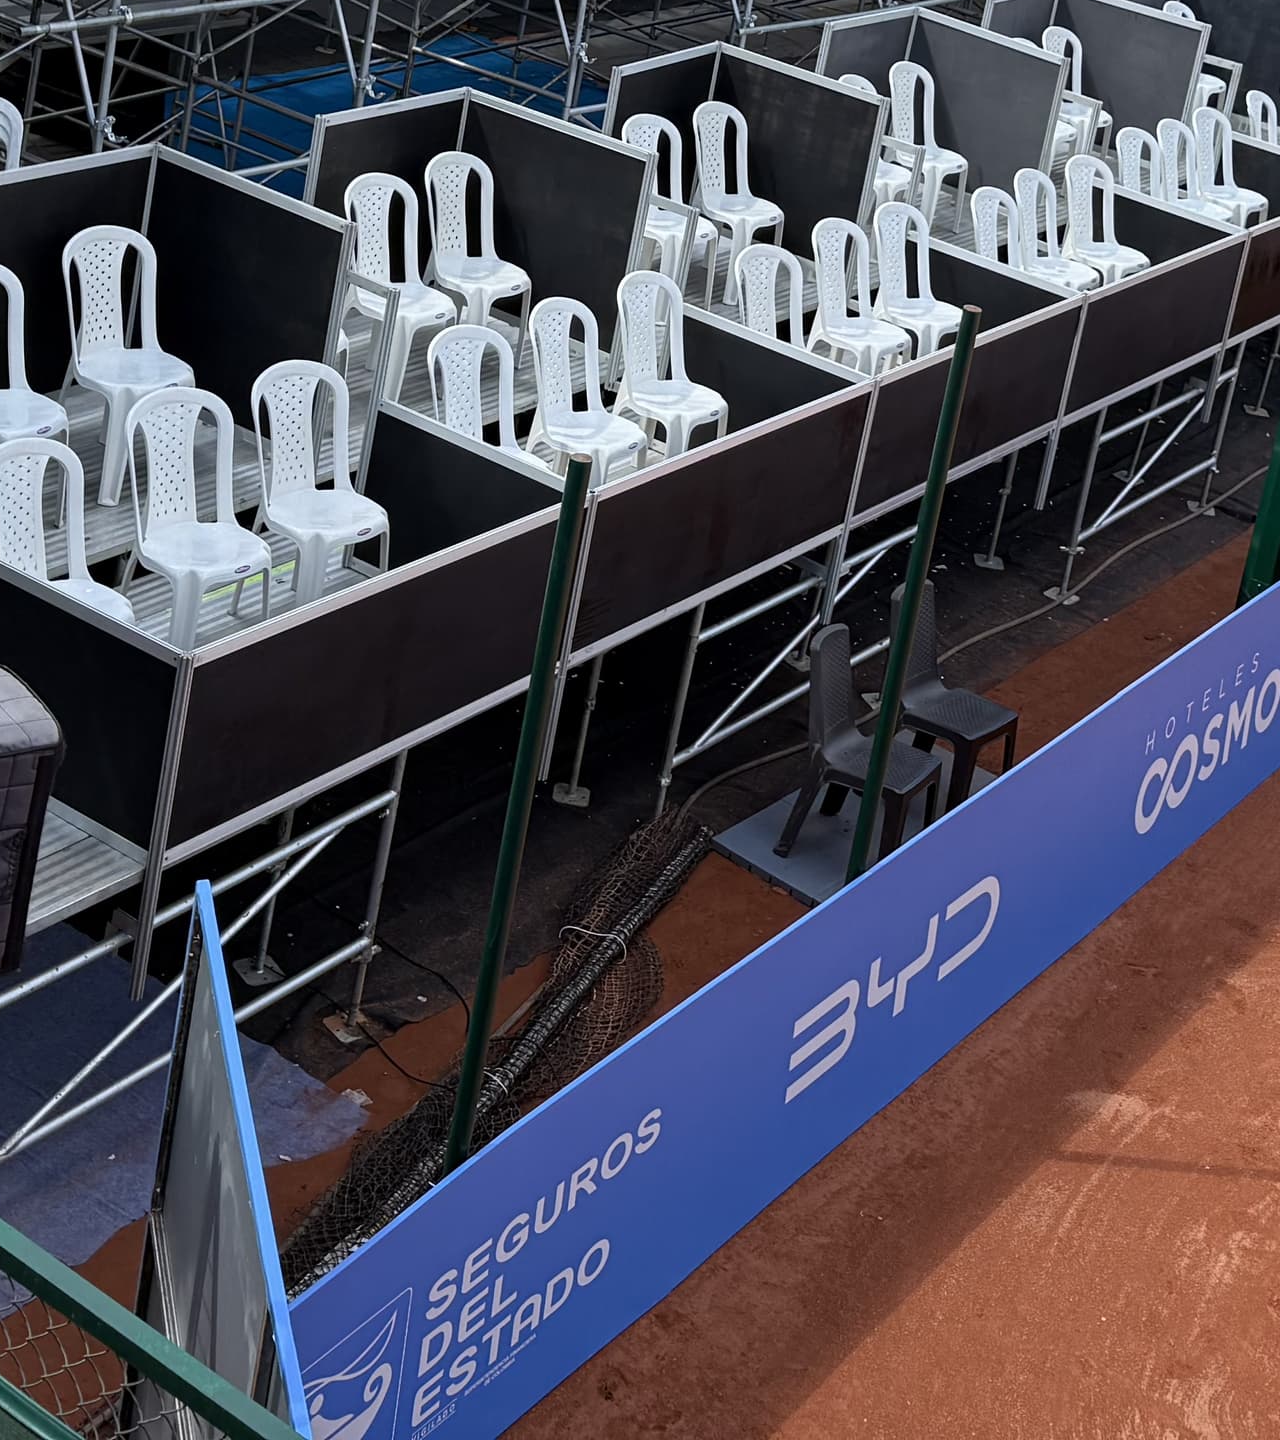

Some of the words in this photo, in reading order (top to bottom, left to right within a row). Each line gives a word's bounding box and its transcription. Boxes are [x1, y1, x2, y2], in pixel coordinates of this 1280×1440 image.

[1145, 652, 1260, 755] HOTELES
[785, 876, 1000, 1104] BYD
[426, 1108, 662, 1320] SEGUROS
[412, 1239, 610, 1427] ESTADO
[418, 1274, 517, 1378] DEL
